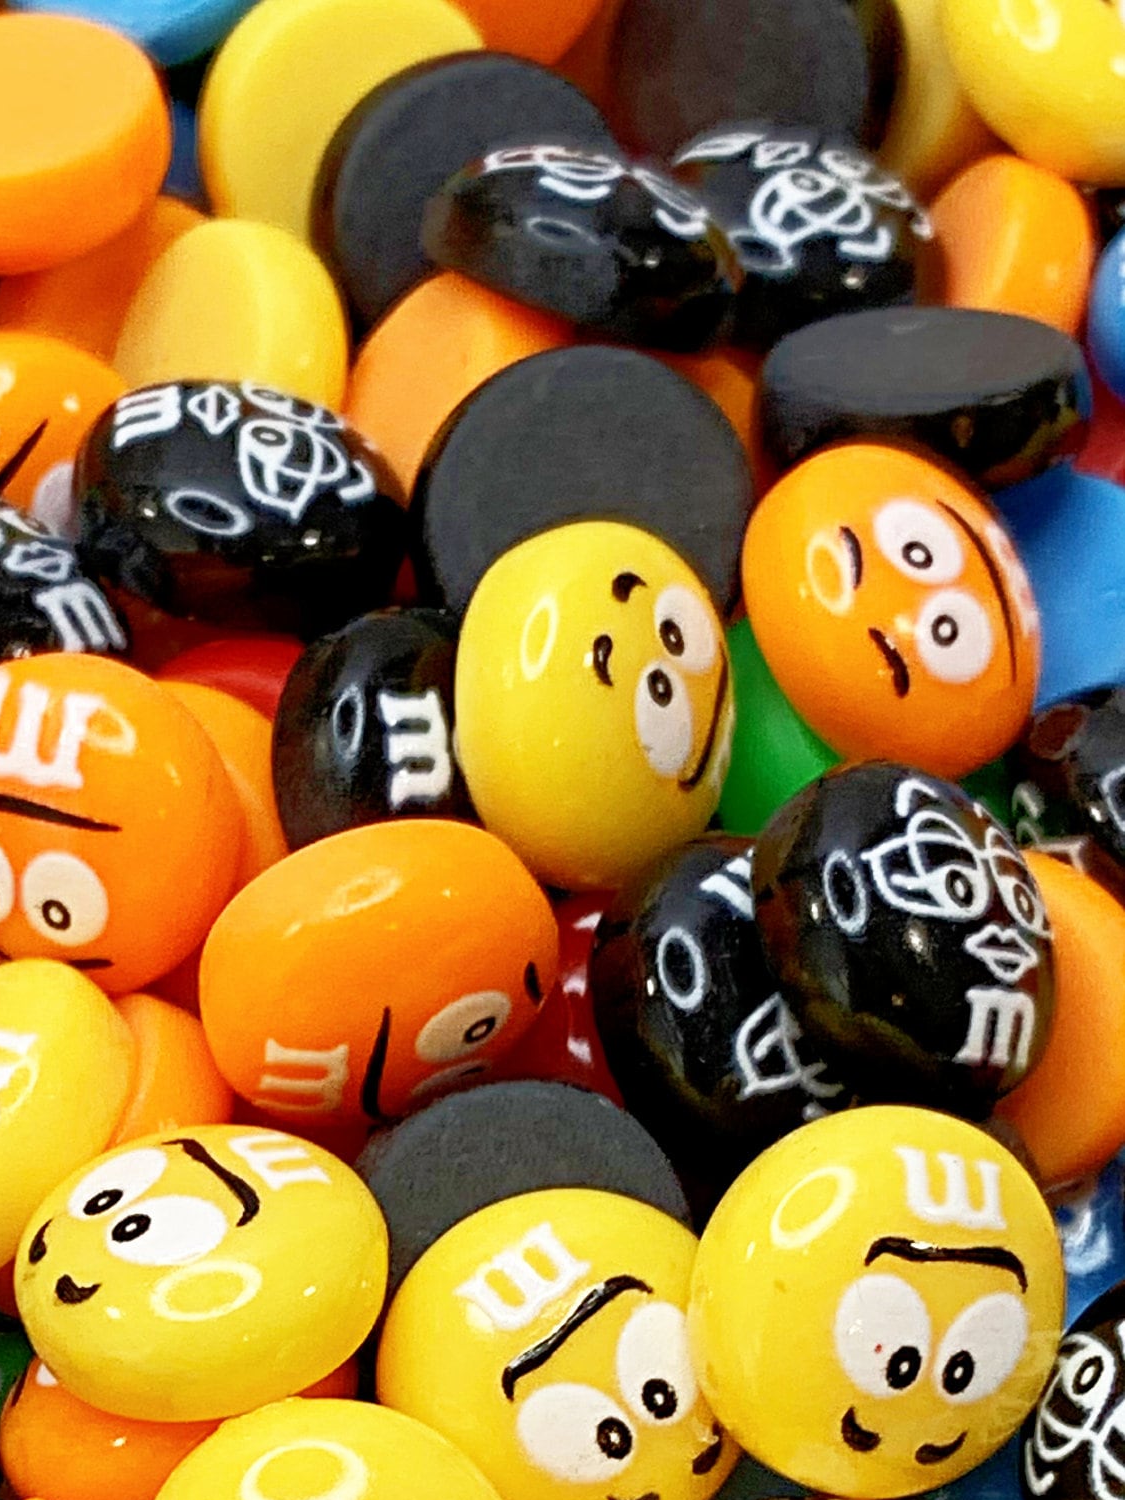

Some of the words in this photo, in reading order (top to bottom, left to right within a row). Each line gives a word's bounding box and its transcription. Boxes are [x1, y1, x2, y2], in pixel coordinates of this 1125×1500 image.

[112, 385, 180, 448] m
[35, 582, 123, 652] m
[375, 690, 447, 807] m
[954, 987, 1036, 1068] m
[895, 1145, 1006, 1231] m
[454, 1222, 590, 1327] m
